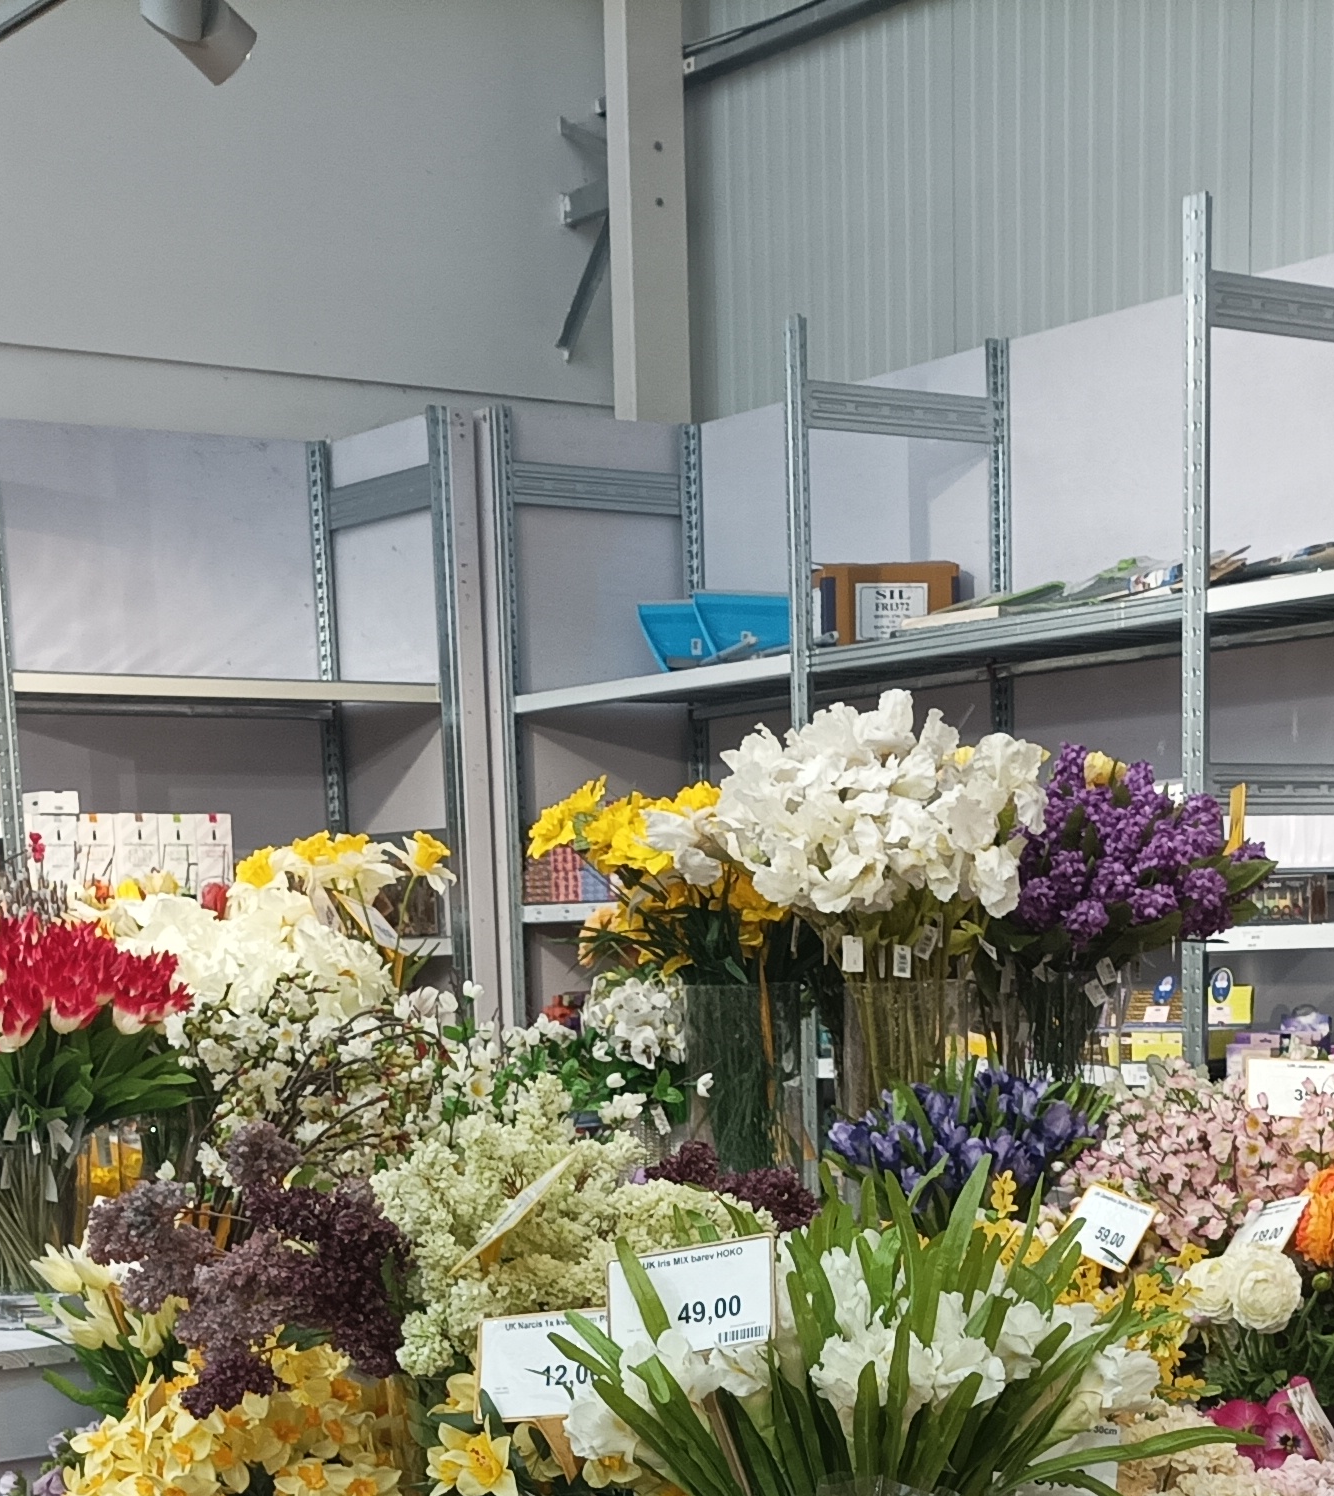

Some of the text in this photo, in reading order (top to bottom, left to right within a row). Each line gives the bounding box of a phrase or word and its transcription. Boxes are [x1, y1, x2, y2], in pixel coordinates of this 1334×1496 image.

[874, 589, 912, 601] SIL
[874, 602, 911, 612] FR1372
[1094, 1226, 1126, 1249] 59,00
[643, 1246, 744, 1271] UK Iris MIX barev HOKO
[677, 1294, 742, 1325] 49,00
[504, 1322, 518, 1332] UK
[518, 1319, 543, 1330] Narcis
